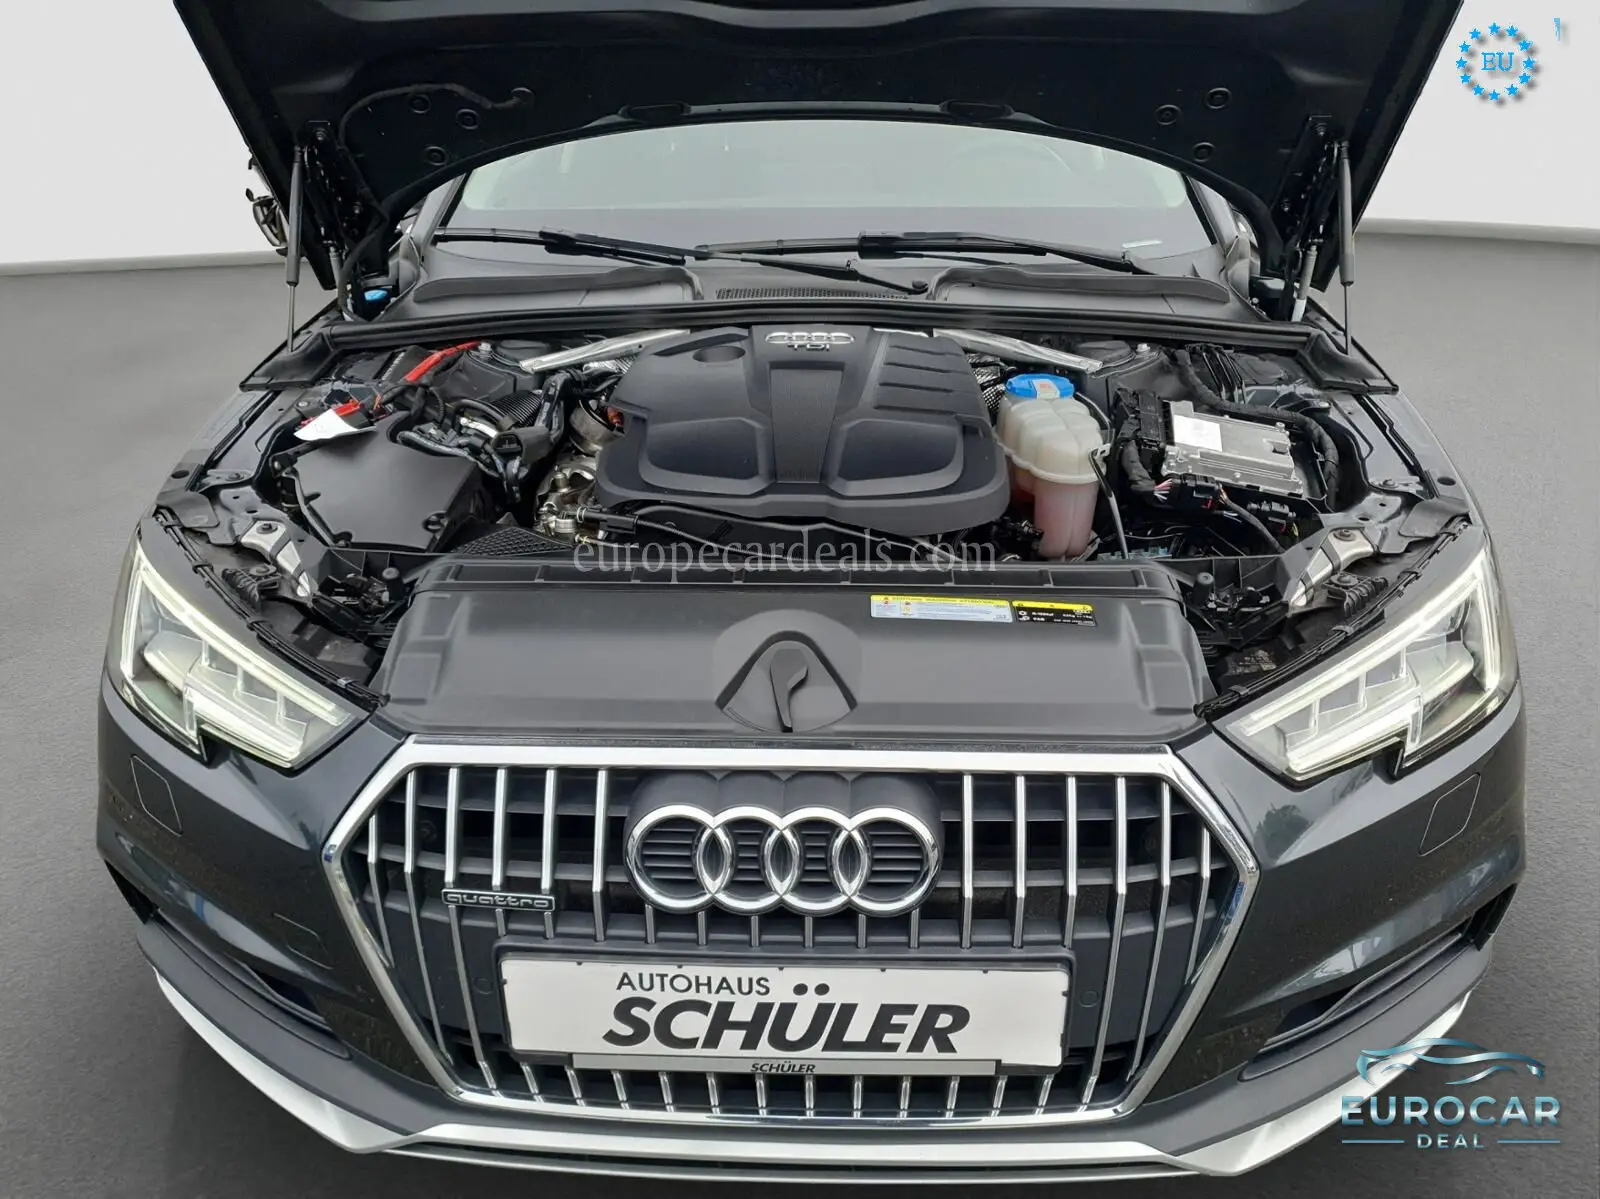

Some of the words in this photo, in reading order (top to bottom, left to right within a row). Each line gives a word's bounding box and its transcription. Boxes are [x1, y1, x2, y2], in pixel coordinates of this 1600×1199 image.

[447, 893, 549, 908] quattro
[616, 972, 770, 996] AUTOHAUS
[602, 983, 971, 1054] SCHÜLER
[750, 1061, 816, 1073] SCHÜLER
